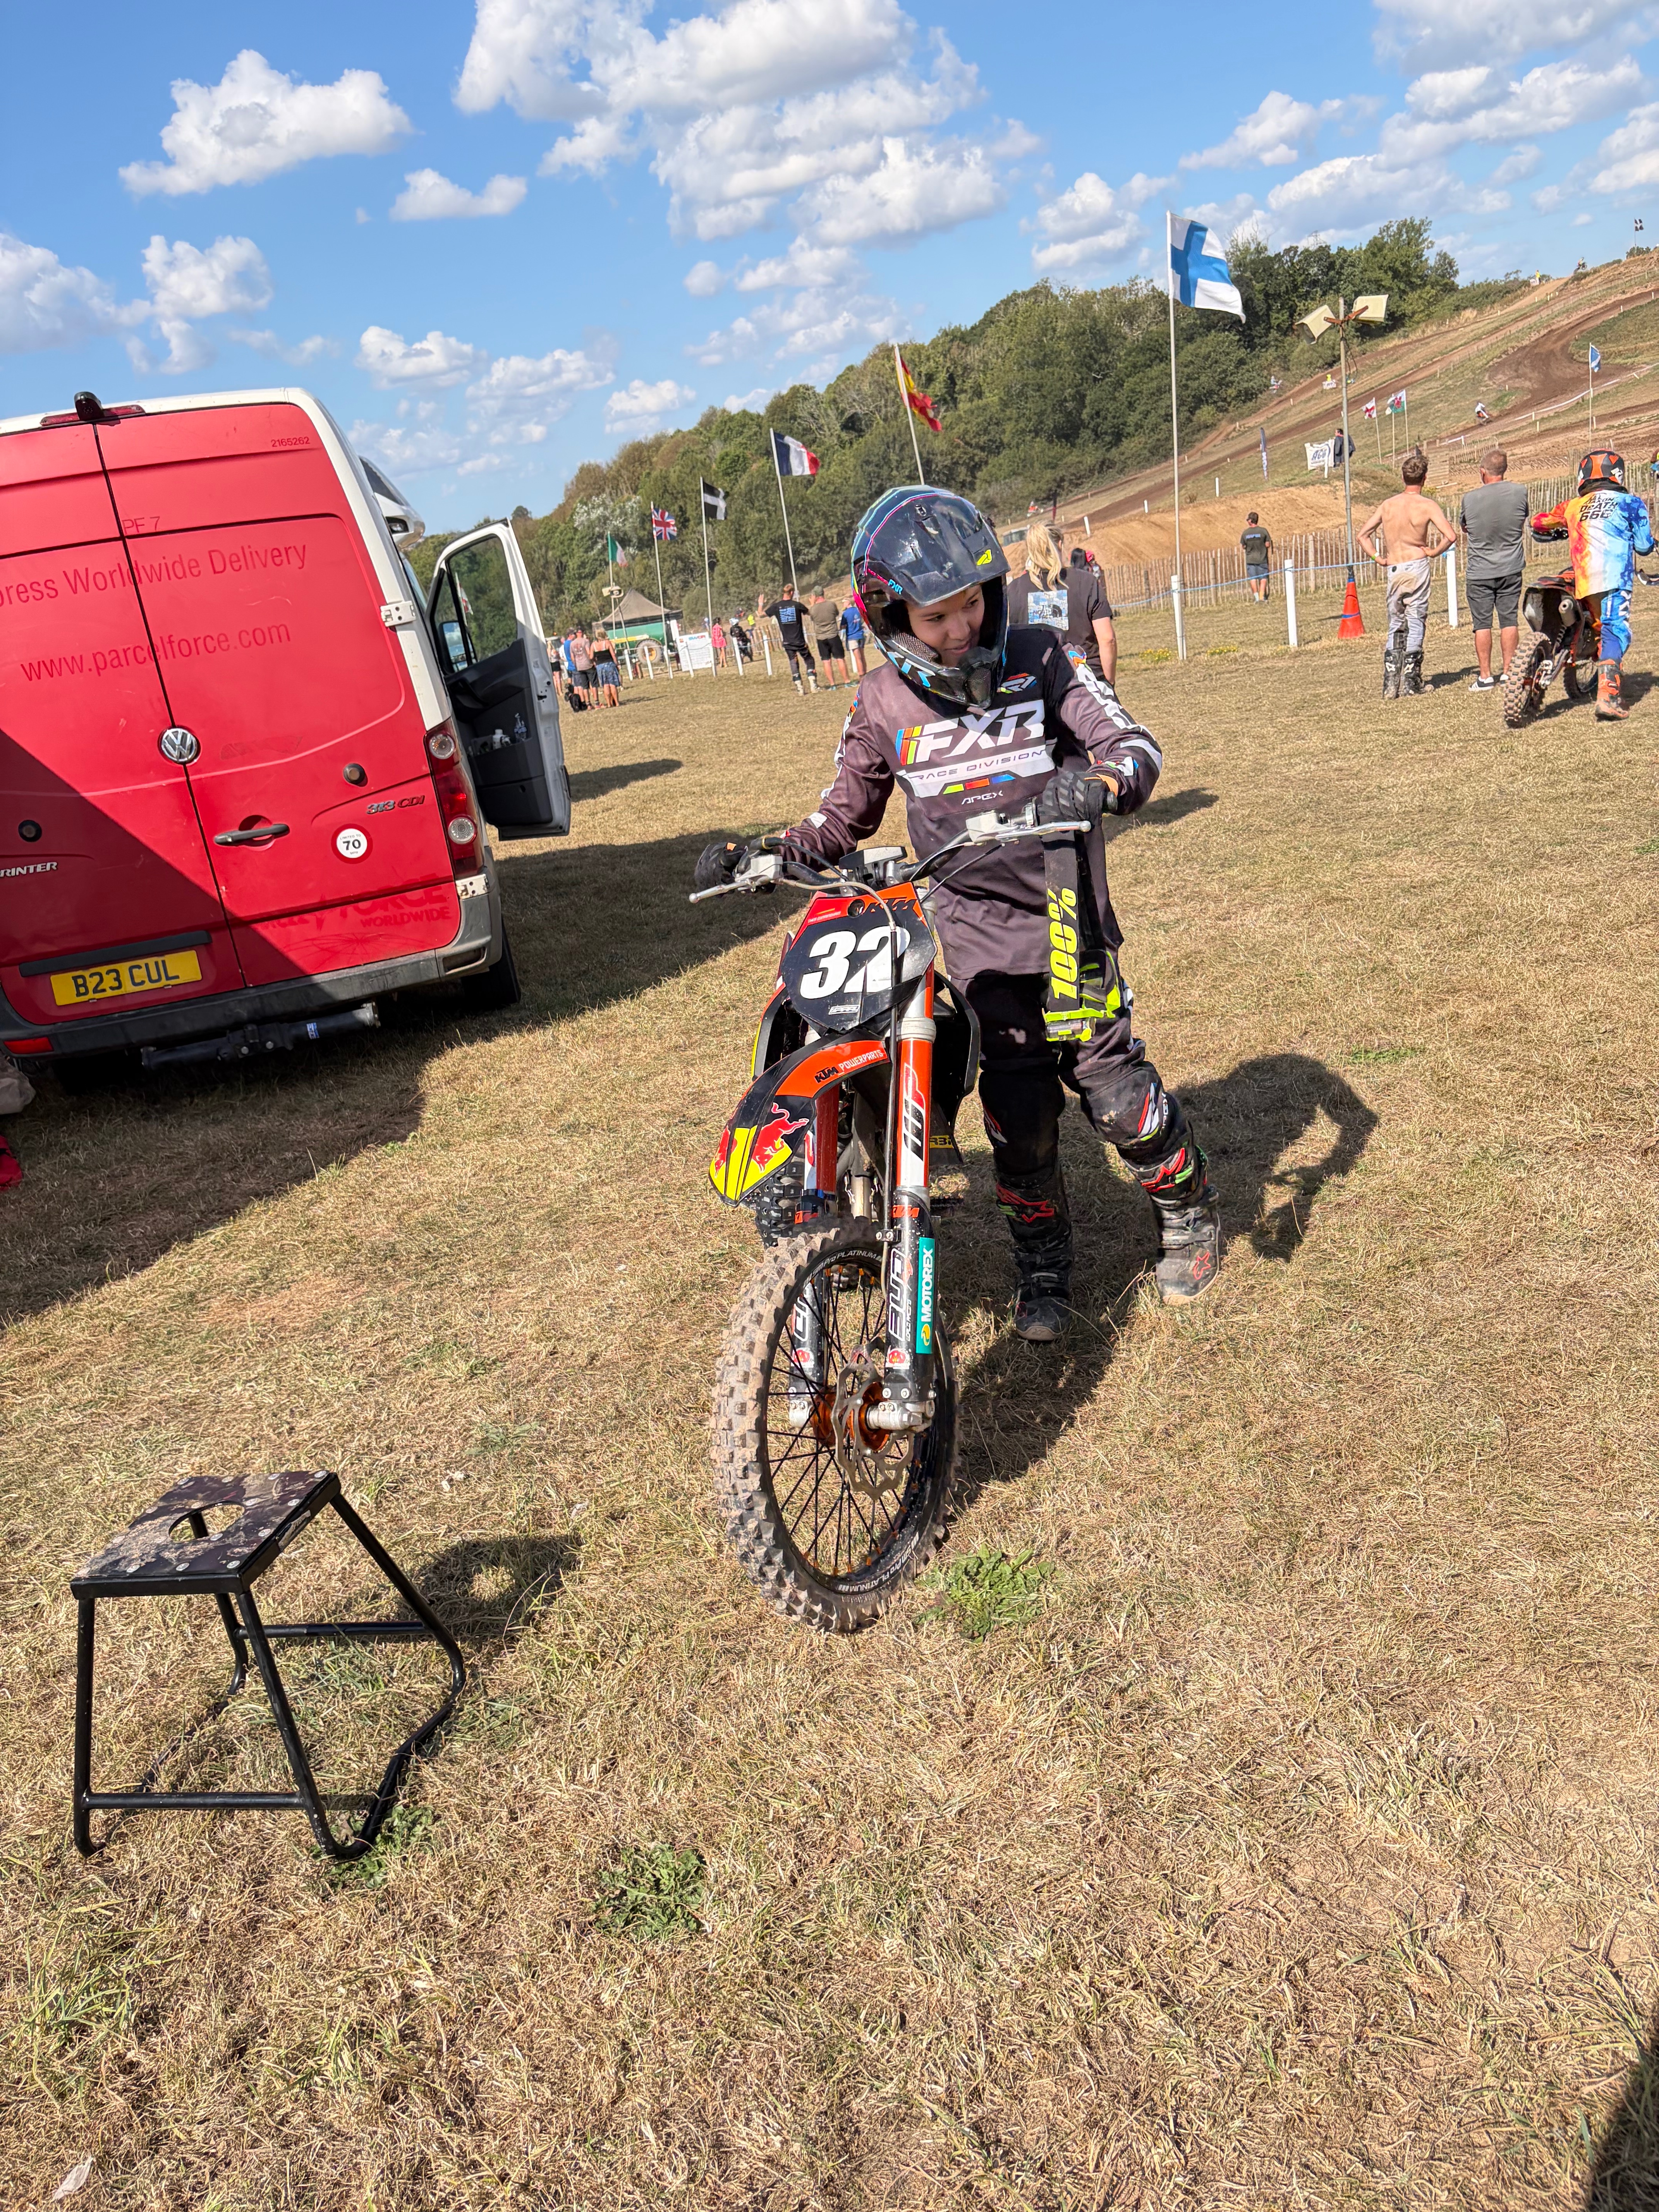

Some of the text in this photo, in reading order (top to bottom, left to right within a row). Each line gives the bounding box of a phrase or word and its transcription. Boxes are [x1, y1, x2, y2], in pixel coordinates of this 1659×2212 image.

[271, 436, 311, 447] 2165262
[122, 516, 160, 534] PF 7
[1579, 509, 1613, 522] 666
[62, 553, 202, 595] Worldwide
[208, 544, 307, 575] Delivery
[21, 622, 291, 682] www.parcelforce.com
[915, 699, 1045, 763] FXR
[909, 749, 1046, 781] RACE DIVISION
[367, 795, 425, 814] 313 CDI
[961, 790, 1004, 805] APEX
[343, 839, 361, 851] 70
[360, 906, 452, 928] WORLDWIDE
[1047, 888, 1078, 1000] 100%
[800, 926, 911, 1000] 32
[72, 959, 180, 998] B23 CUL
[814, 1066, 839, 1083] KTM
[837, 1250, 877, 1259] PLATINUM
[921, 1247, 933, 1322] MOTOREX
[850, 1571, 890, 1592] PLATINUM
